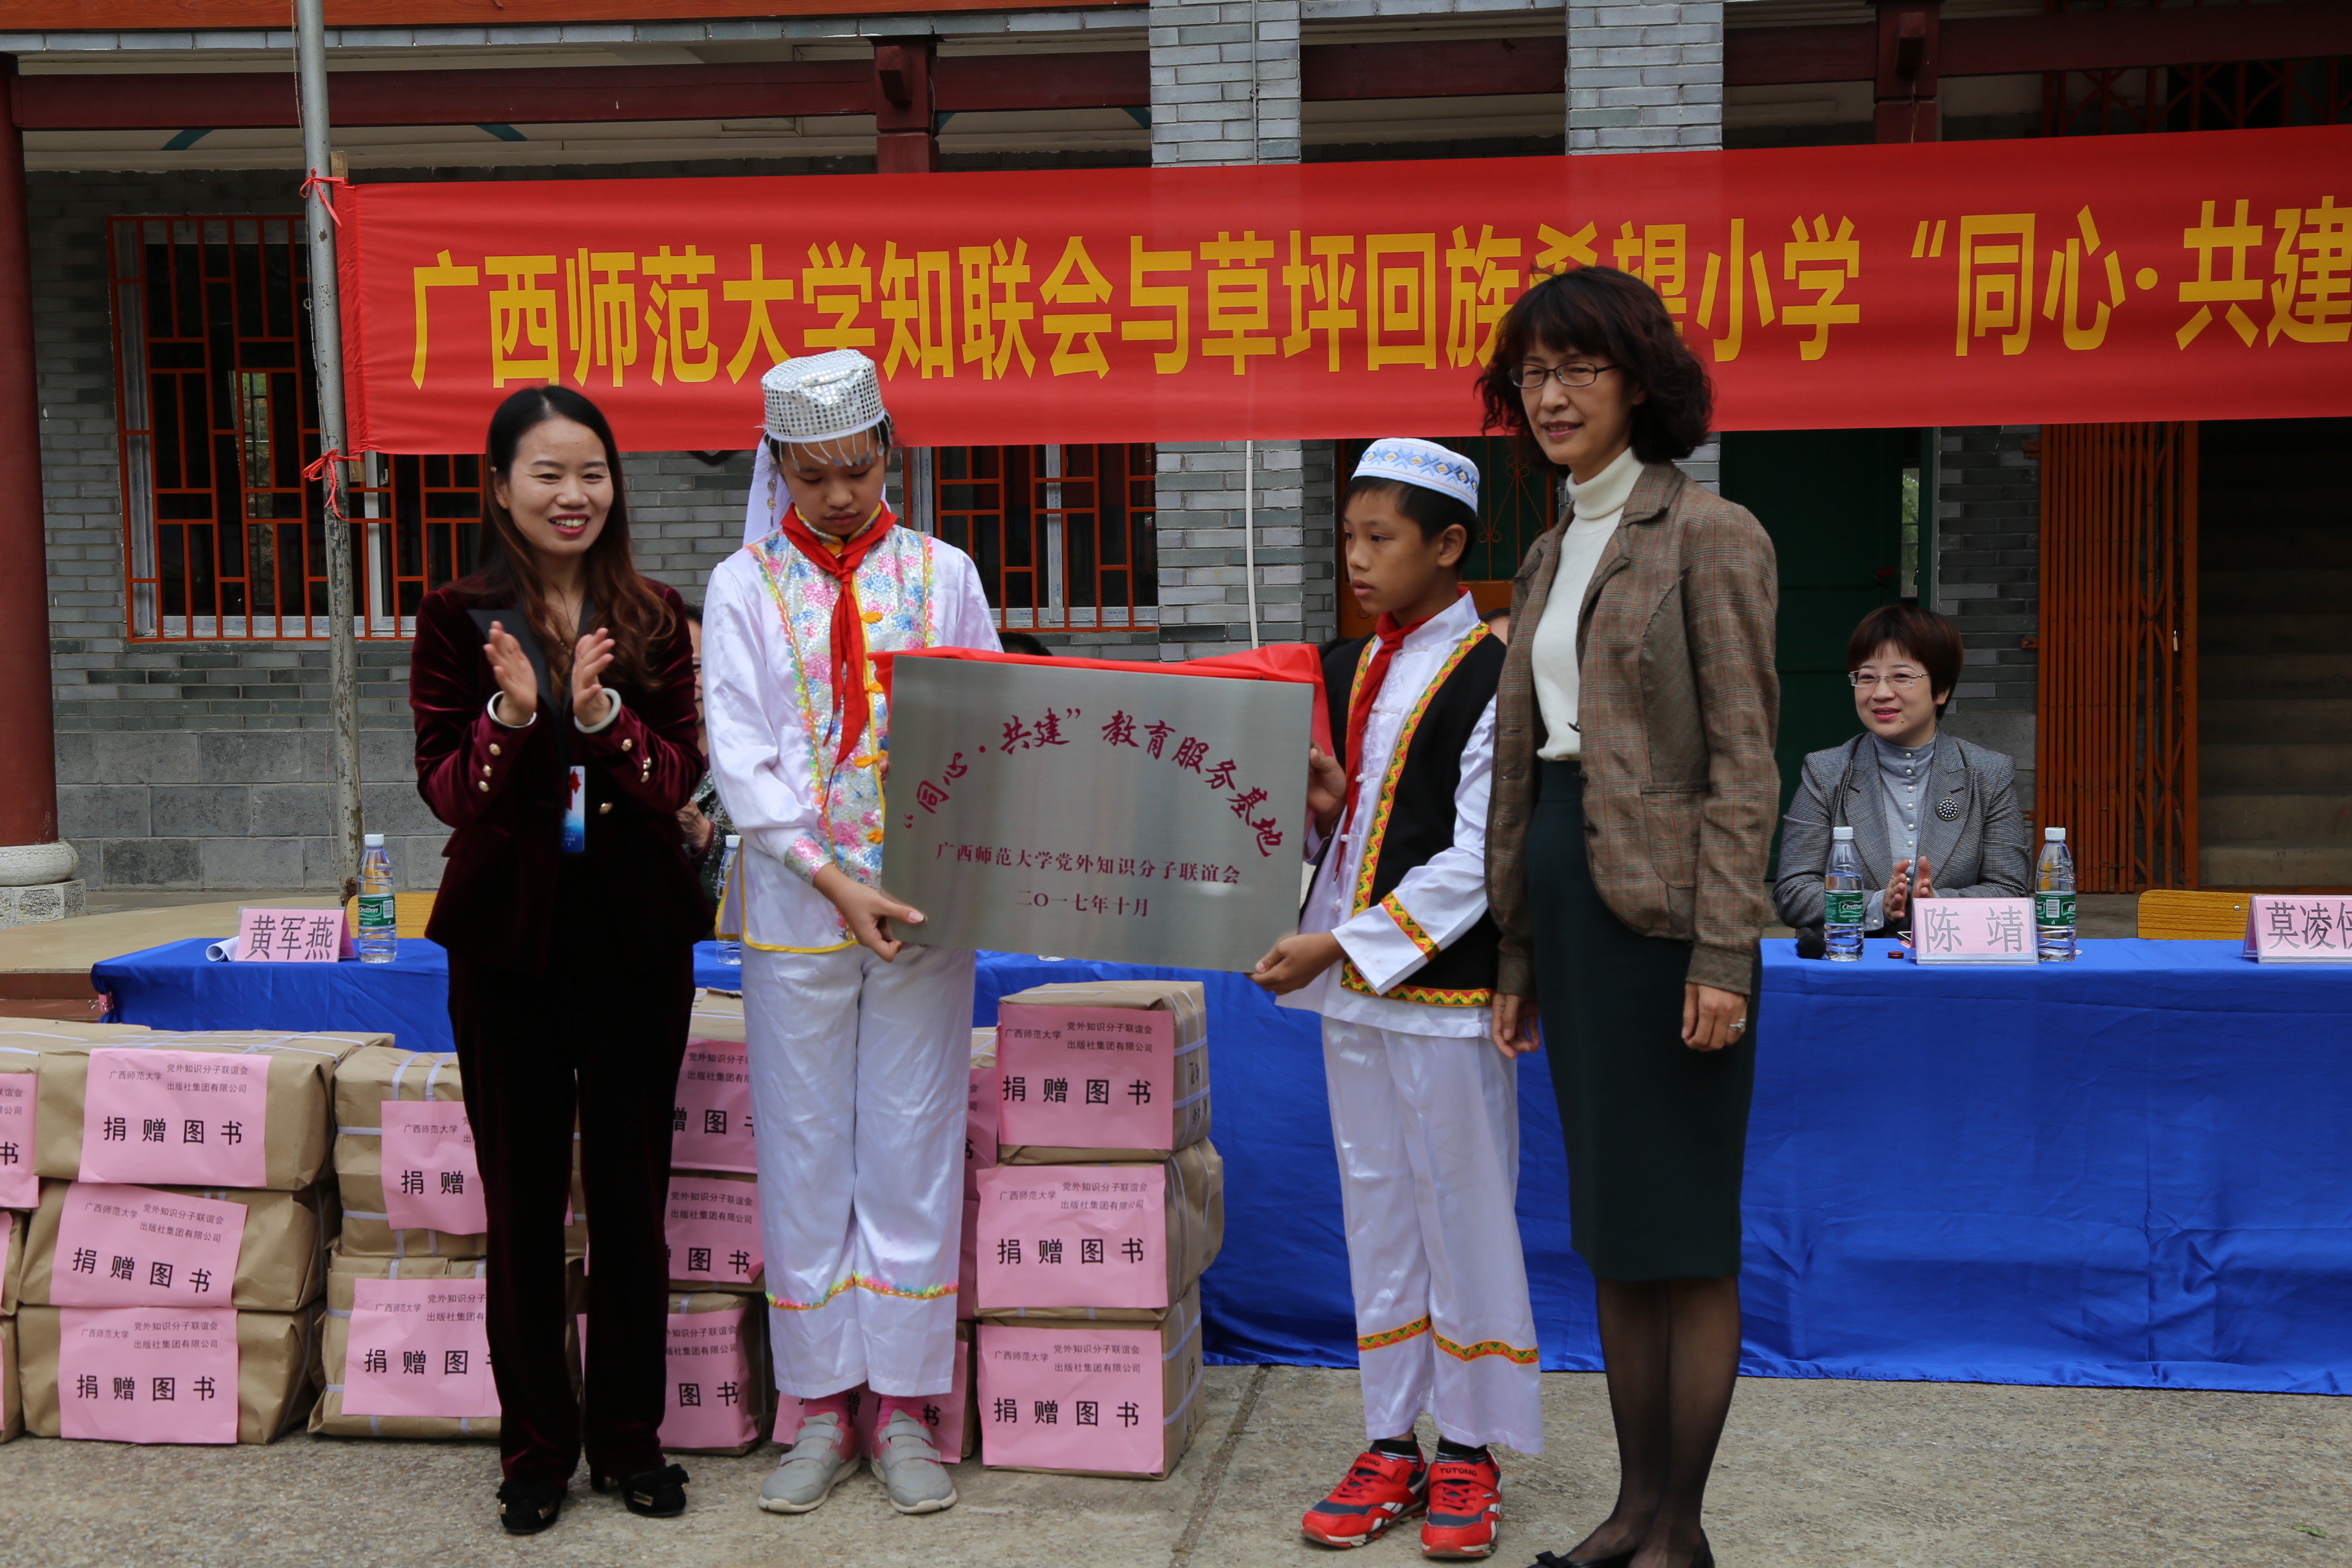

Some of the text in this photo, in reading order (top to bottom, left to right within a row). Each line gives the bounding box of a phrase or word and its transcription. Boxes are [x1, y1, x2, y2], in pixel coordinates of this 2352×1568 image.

[936, 841, 1241, 885] 广西师范大学党外知识分子联谊会
[245, 914, 335, 961] 黄军燕
[1004, 1028, 1062, 1040] 广西师范大学
[1066, 1021, 1153, 1035] 党外知识分子联谊会
[1067, 1040, 1153, 1054] 出版社集团有限公司
[688, 1052, 749, 1065] 党外知识分子
[109, 1070, 162, 1081] 广西师范大学
[166, 1063, 249, 1076] 党外知识分子联谊会
[167, 1081, 247, 1094] 出版社集团有限公司
[403, 1124, 458, 1134] 广西师范大学
[1062, 1182, 1148, 1192] 党外知识分子联谊会
[671, 1191, 753, 1207] 党外知识分子联谊会
[999, 1190, 1056, 1200] 广西师范大学
[84, 1202, 138, 1219] 广西师范大学
[1060, 1199, 1144, 1211] 出版社集团有限公司
[143, 1203, 225, 1225] 党外知识分子联谊会
[671, 1209, 752, 1225] 出版社集团有限公司
[139, 1222, 221, 1243] 出版社集团有限公司
[375, 1302, 422, 1313] 广西师范大学
[133, 1321, 219, 1331] 党外知识分子联谊会
[80, 1328, 130, 1340] 广西师范大学
[133, 1339, 219, 1350] 出版社集团有限公司
[1054, 1344, 1141, 1355] 党外知识分子联谊会
[994, 1351, 1049, 1362] 广西师范大学
[1054, 1363, 1141, 1374] 出版社集团有限公司
